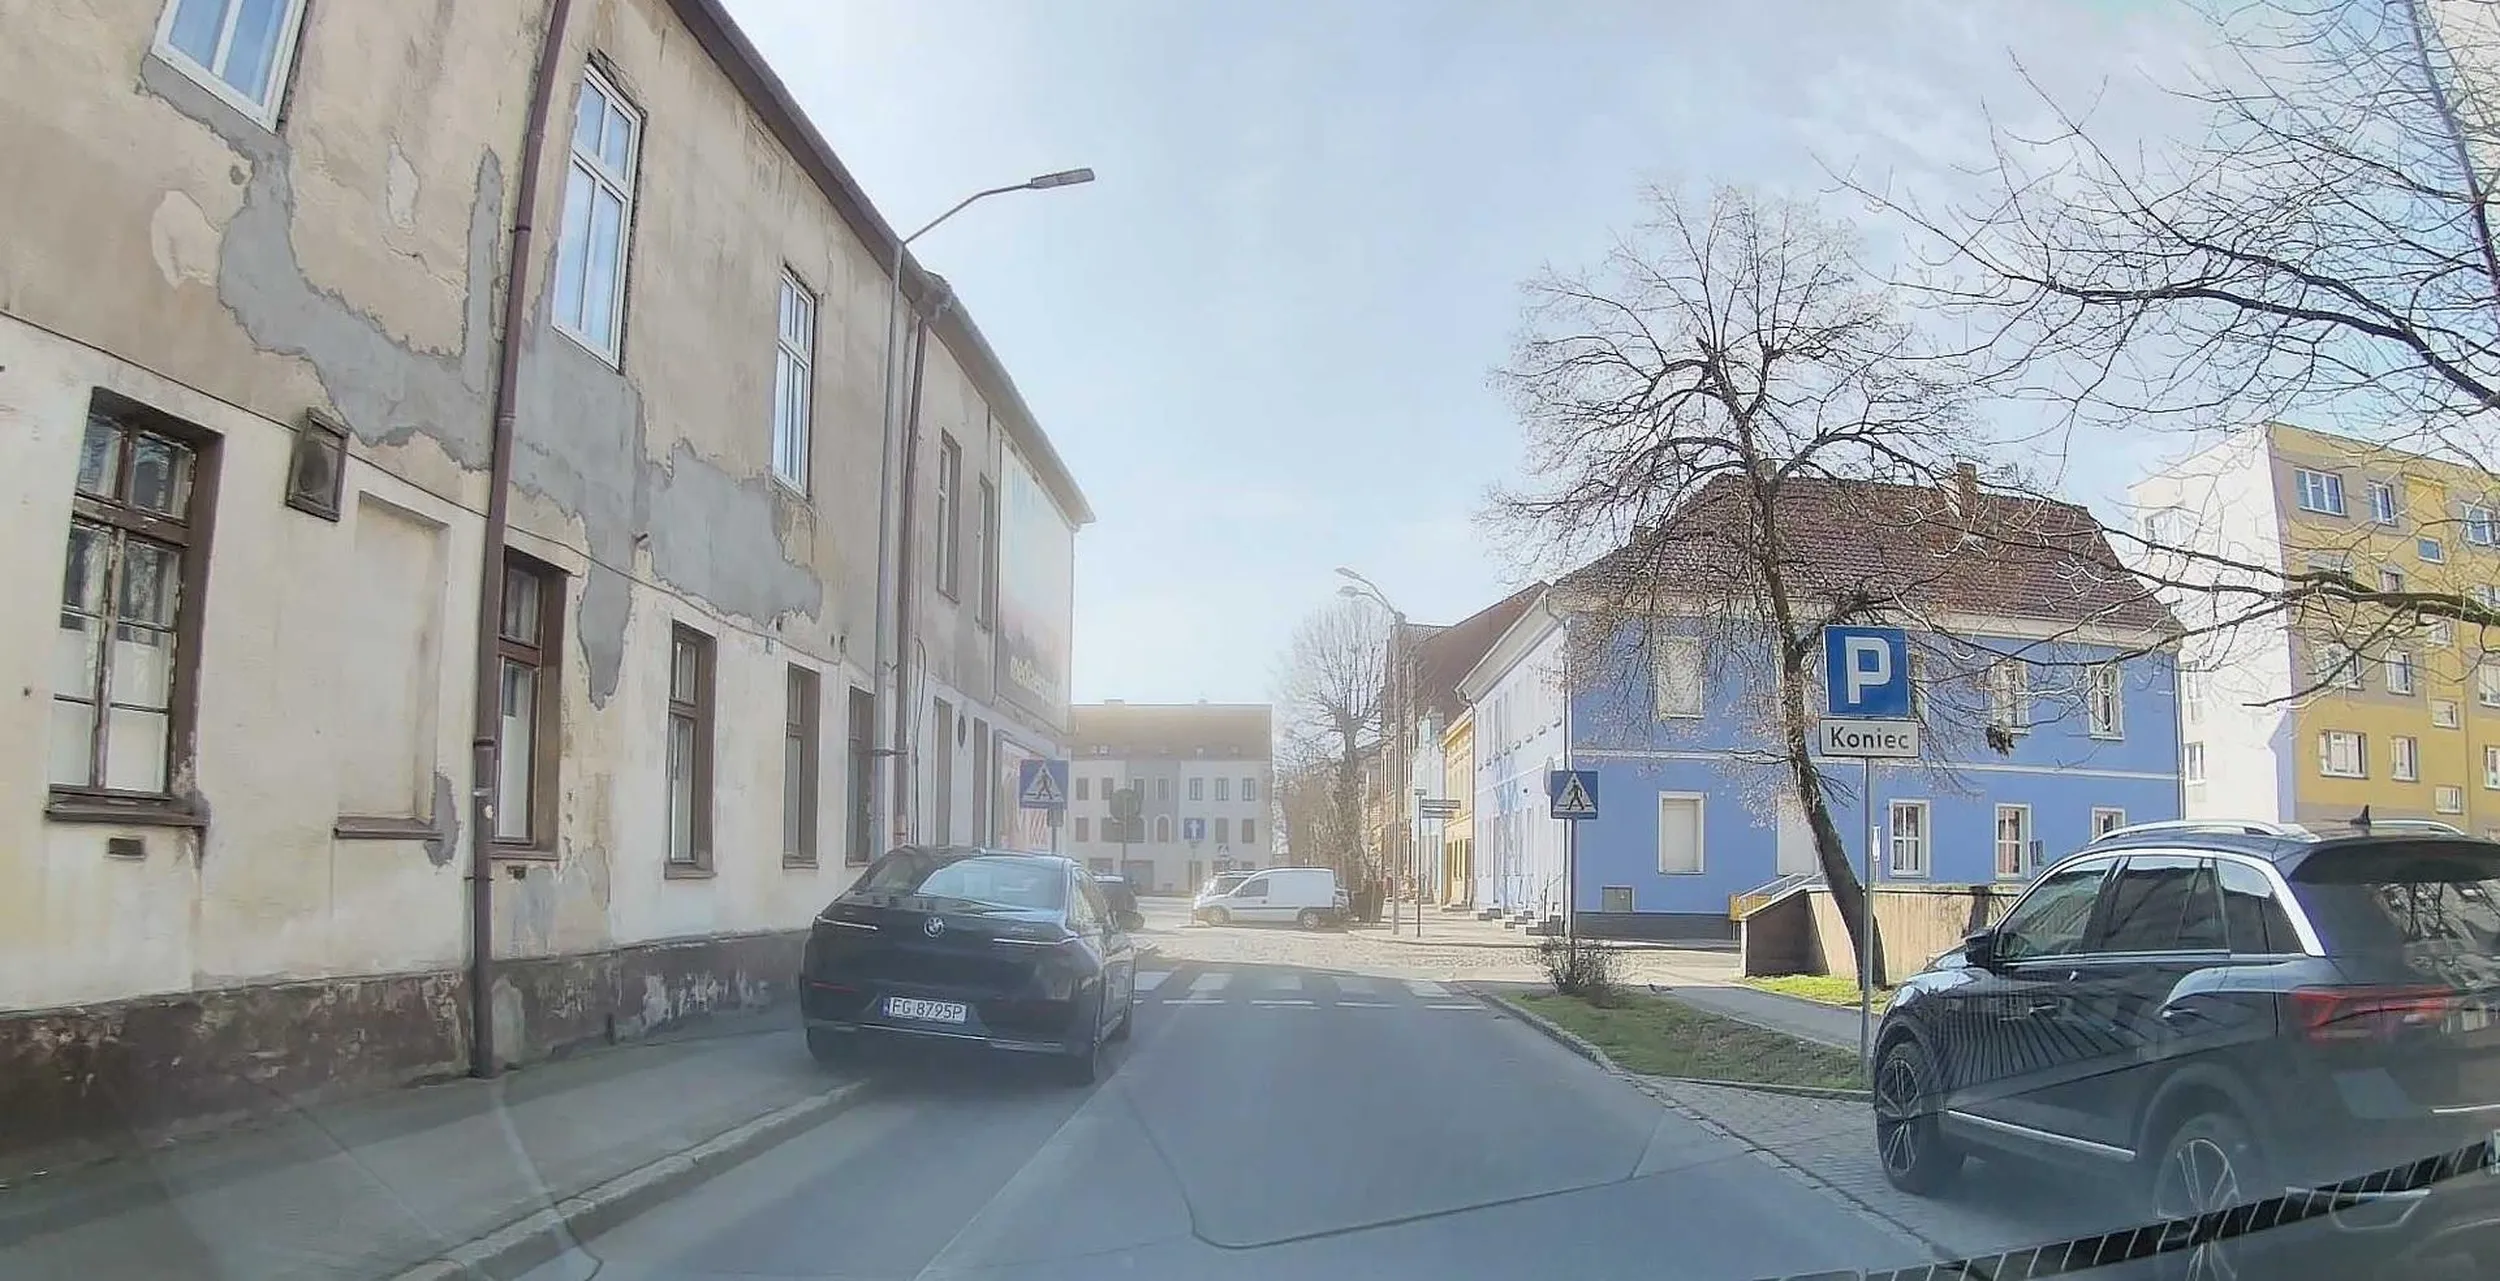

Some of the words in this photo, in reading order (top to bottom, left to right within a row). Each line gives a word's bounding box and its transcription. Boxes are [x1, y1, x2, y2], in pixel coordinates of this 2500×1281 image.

[1845, 635, 1891, 704] P
[1830, 726, 1909, 749] Koniec
[892, 999, 911, 1014] FG
[916, 1002, 962, 1019] 8795P
